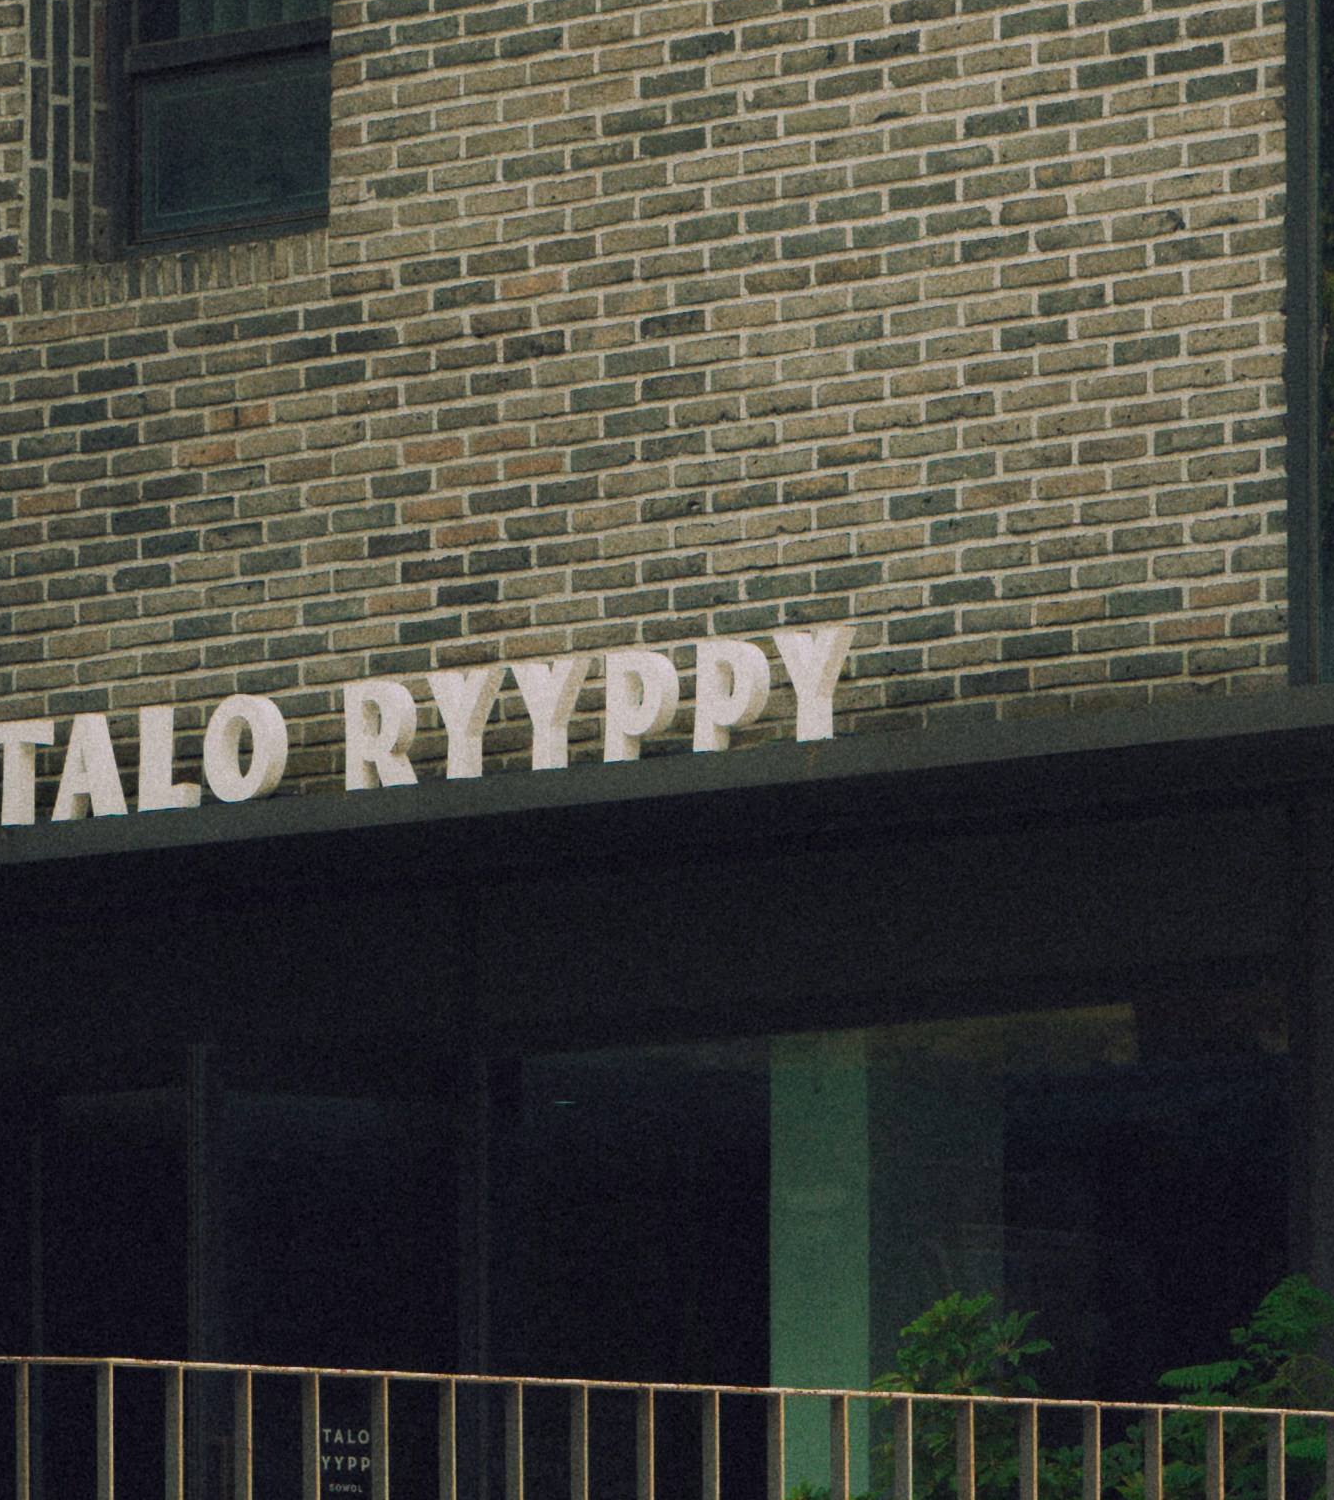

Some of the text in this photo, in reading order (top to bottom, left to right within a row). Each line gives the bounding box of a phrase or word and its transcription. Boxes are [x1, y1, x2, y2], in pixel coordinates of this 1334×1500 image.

[342, 626, 853, 791] RYYPPY
[322, 1428, 370, 1444] TALO
[329, 1483, 363, 1493] SOWOL
